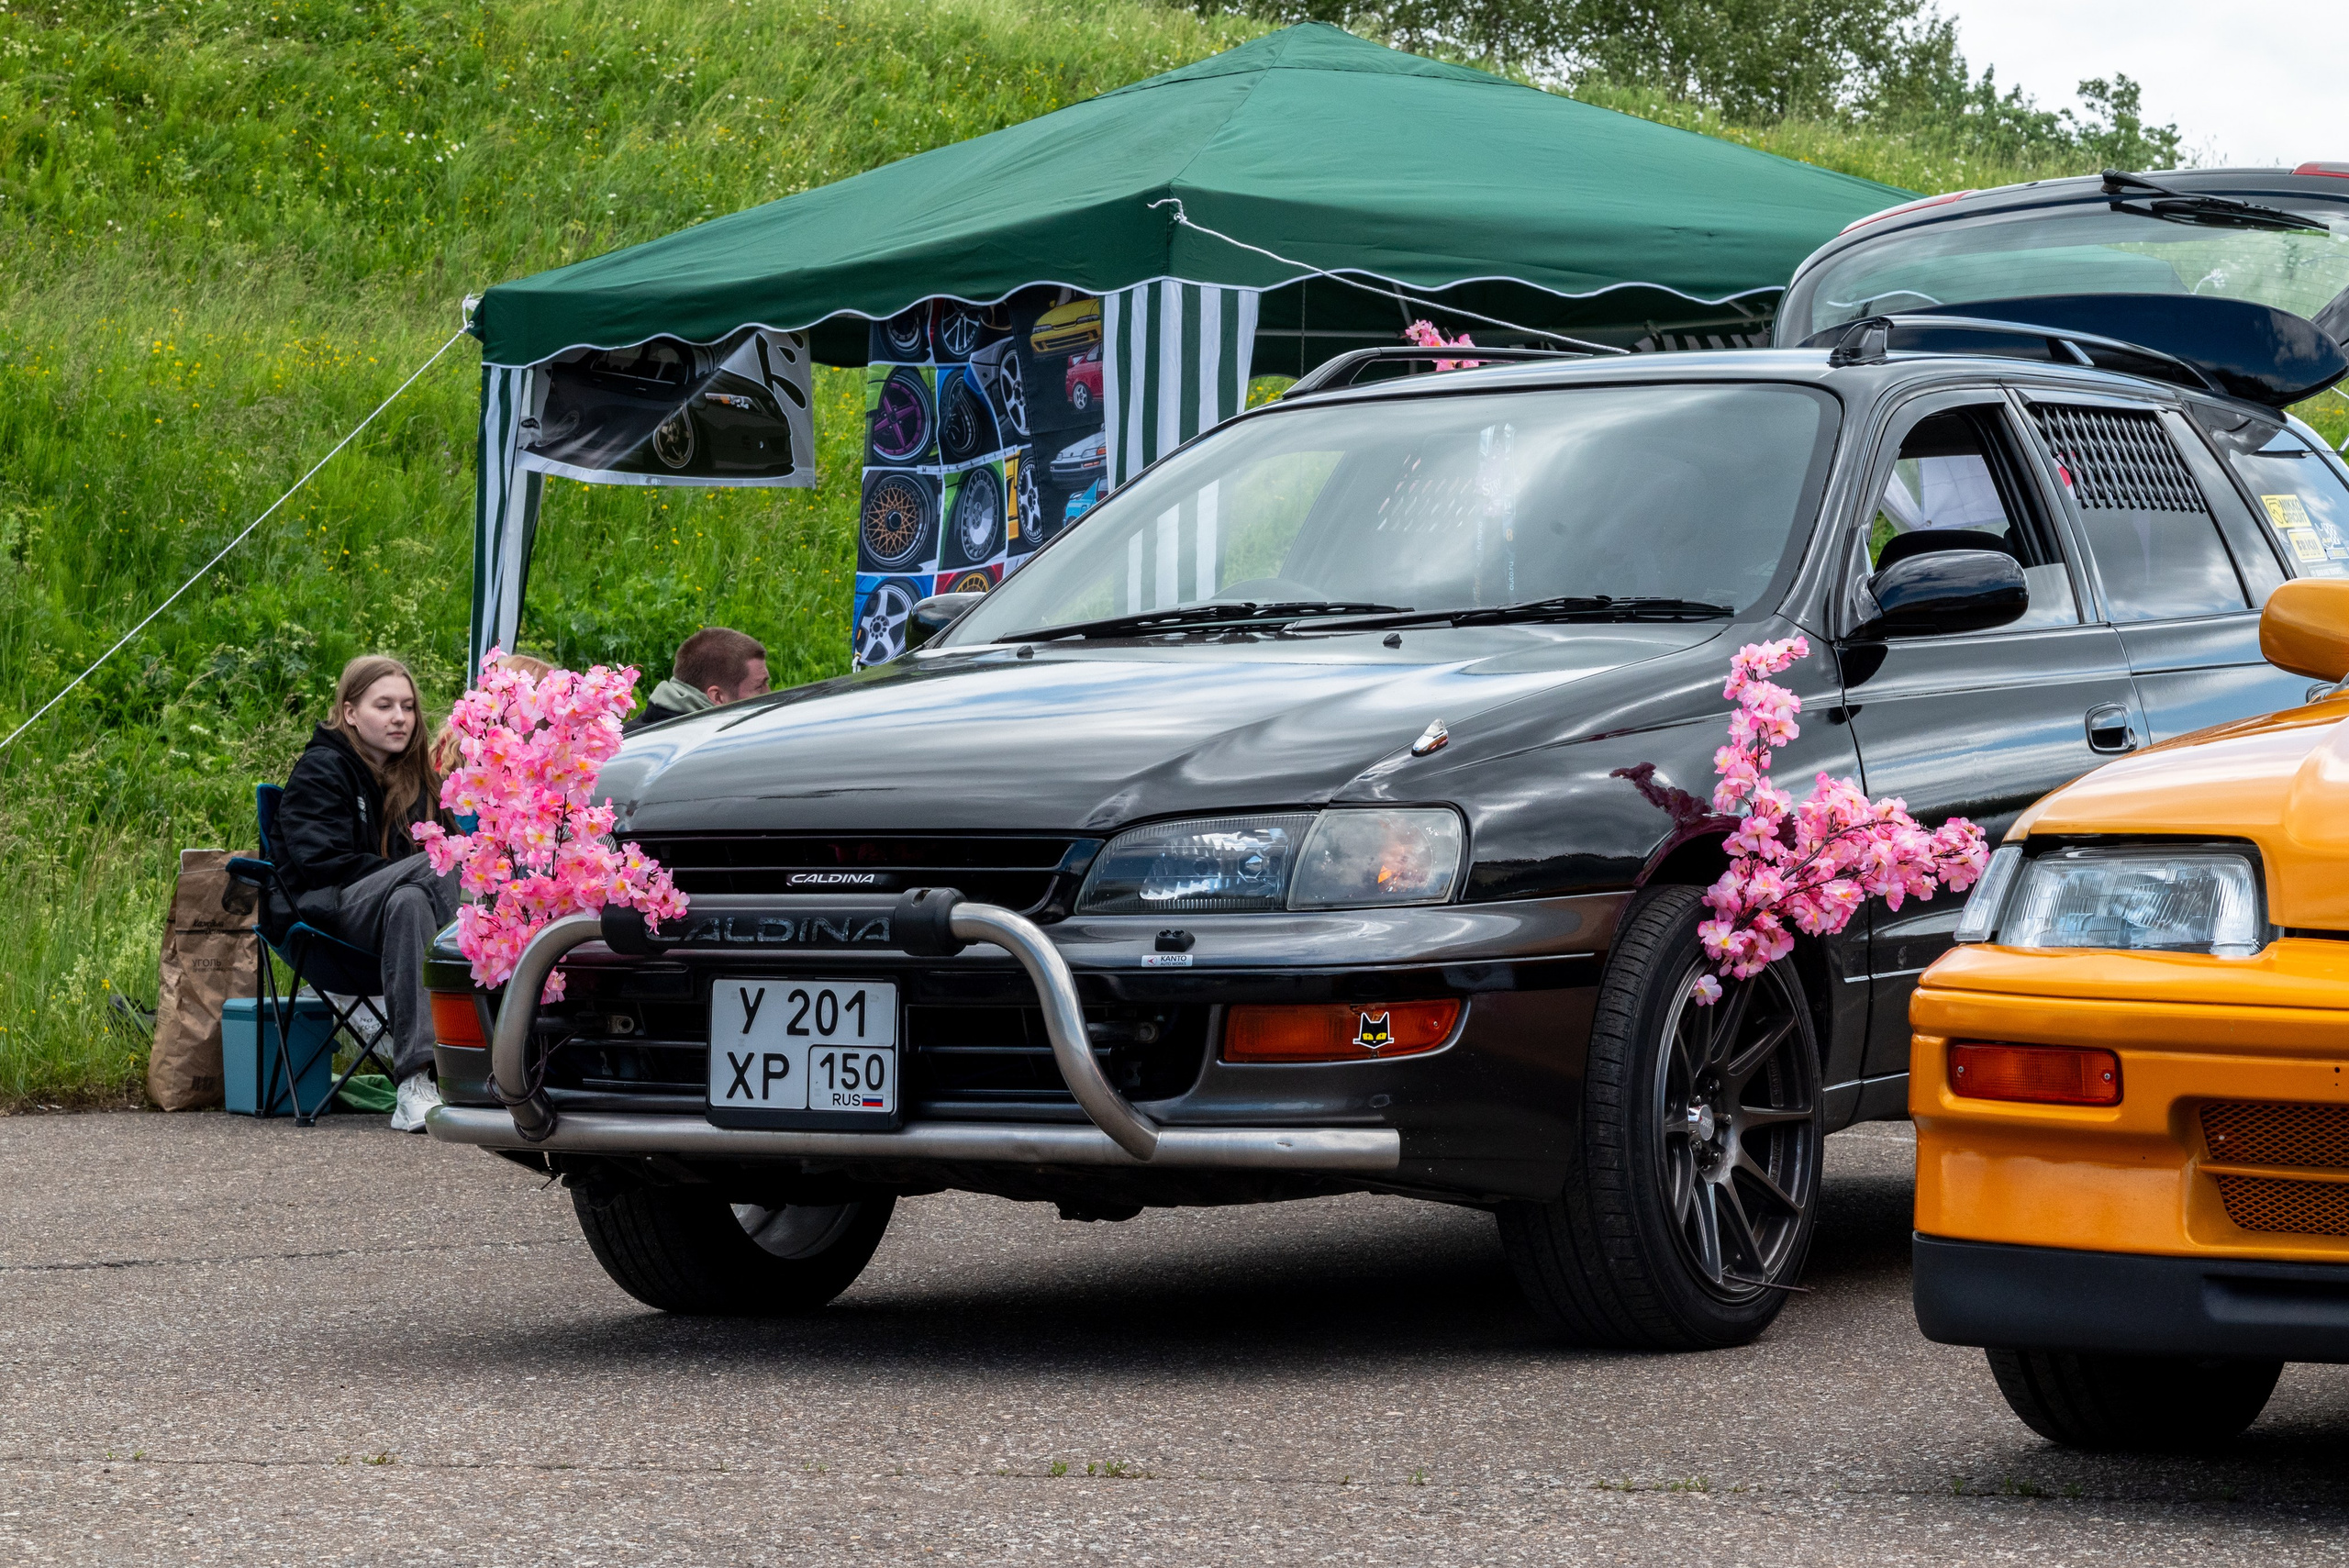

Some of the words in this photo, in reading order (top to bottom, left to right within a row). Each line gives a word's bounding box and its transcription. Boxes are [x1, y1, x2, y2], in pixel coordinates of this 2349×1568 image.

[2278, 498, 2302, 511] NIKKO
[2282, 512, 2308, 524] CIRCUIT
[791, 873, 875, 884] CALDINA
[191, 959, 222, 967] УГОЛЬ
[740, 987, 765, 1034] У
[786, 988, 865, 1038] 201
[819, 1052, 885, 1091] 150
[832, 1093, 861, 1106] RUS
